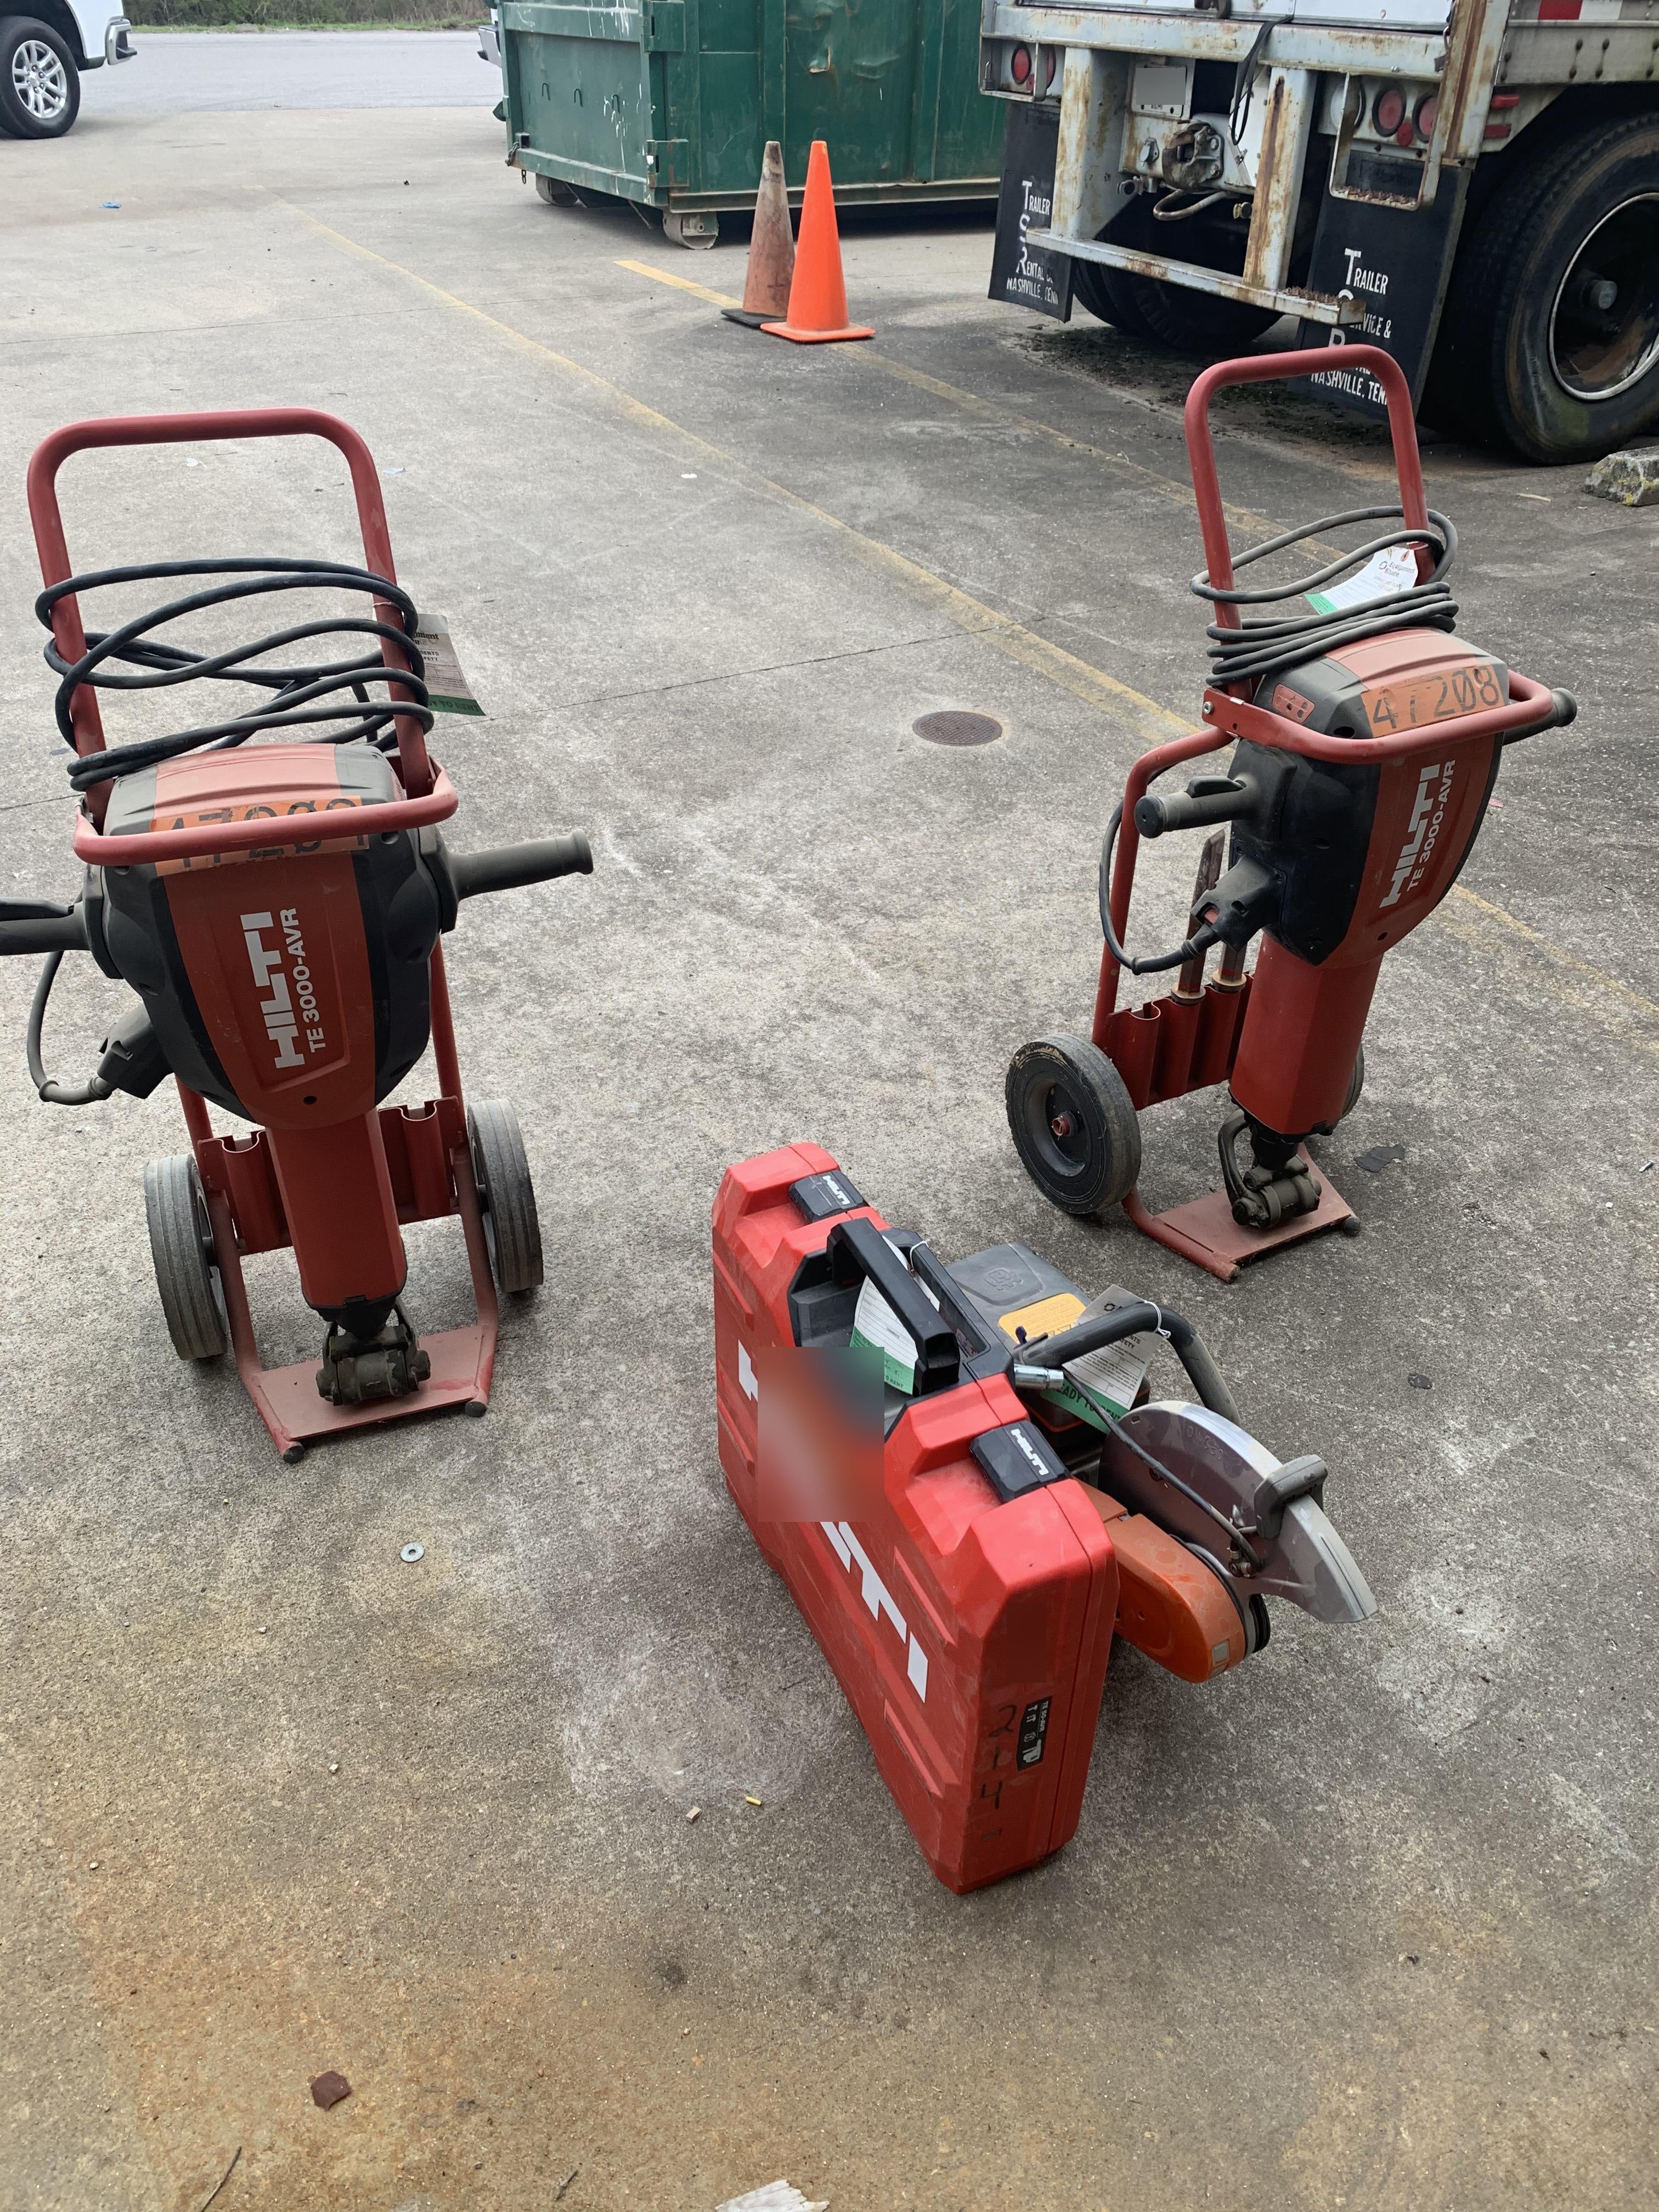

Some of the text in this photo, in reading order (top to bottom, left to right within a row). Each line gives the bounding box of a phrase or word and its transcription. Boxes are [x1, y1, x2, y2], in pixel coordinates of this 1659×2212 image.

[1022, 180, 1051, 215] TRAILER
[1016, 246, 1045, 281] RENTAL
[1344, 247, 1389, 295] TRAILER
[1006, 277, 1042, 300] NASHVILLE,
[1384, 319, 1391, 338] &
[1311, 370, 1365, 398] NASHVILLE,
[1379, 764, 1441, 908] HILTI
[1406, 759, 1456, 891] TE 3000-AVR
[240, 911, 306, 1069] HILTI
[280, 907, 326, 1053] TE 3000-AVR
[822, 1175, 850, 1205] HILTI
[890, 1377, 904, 1389] RENT
[1056, 1383, 1082, 1403] ADY
[1011, 1429, 1049, 1475] HILTI
